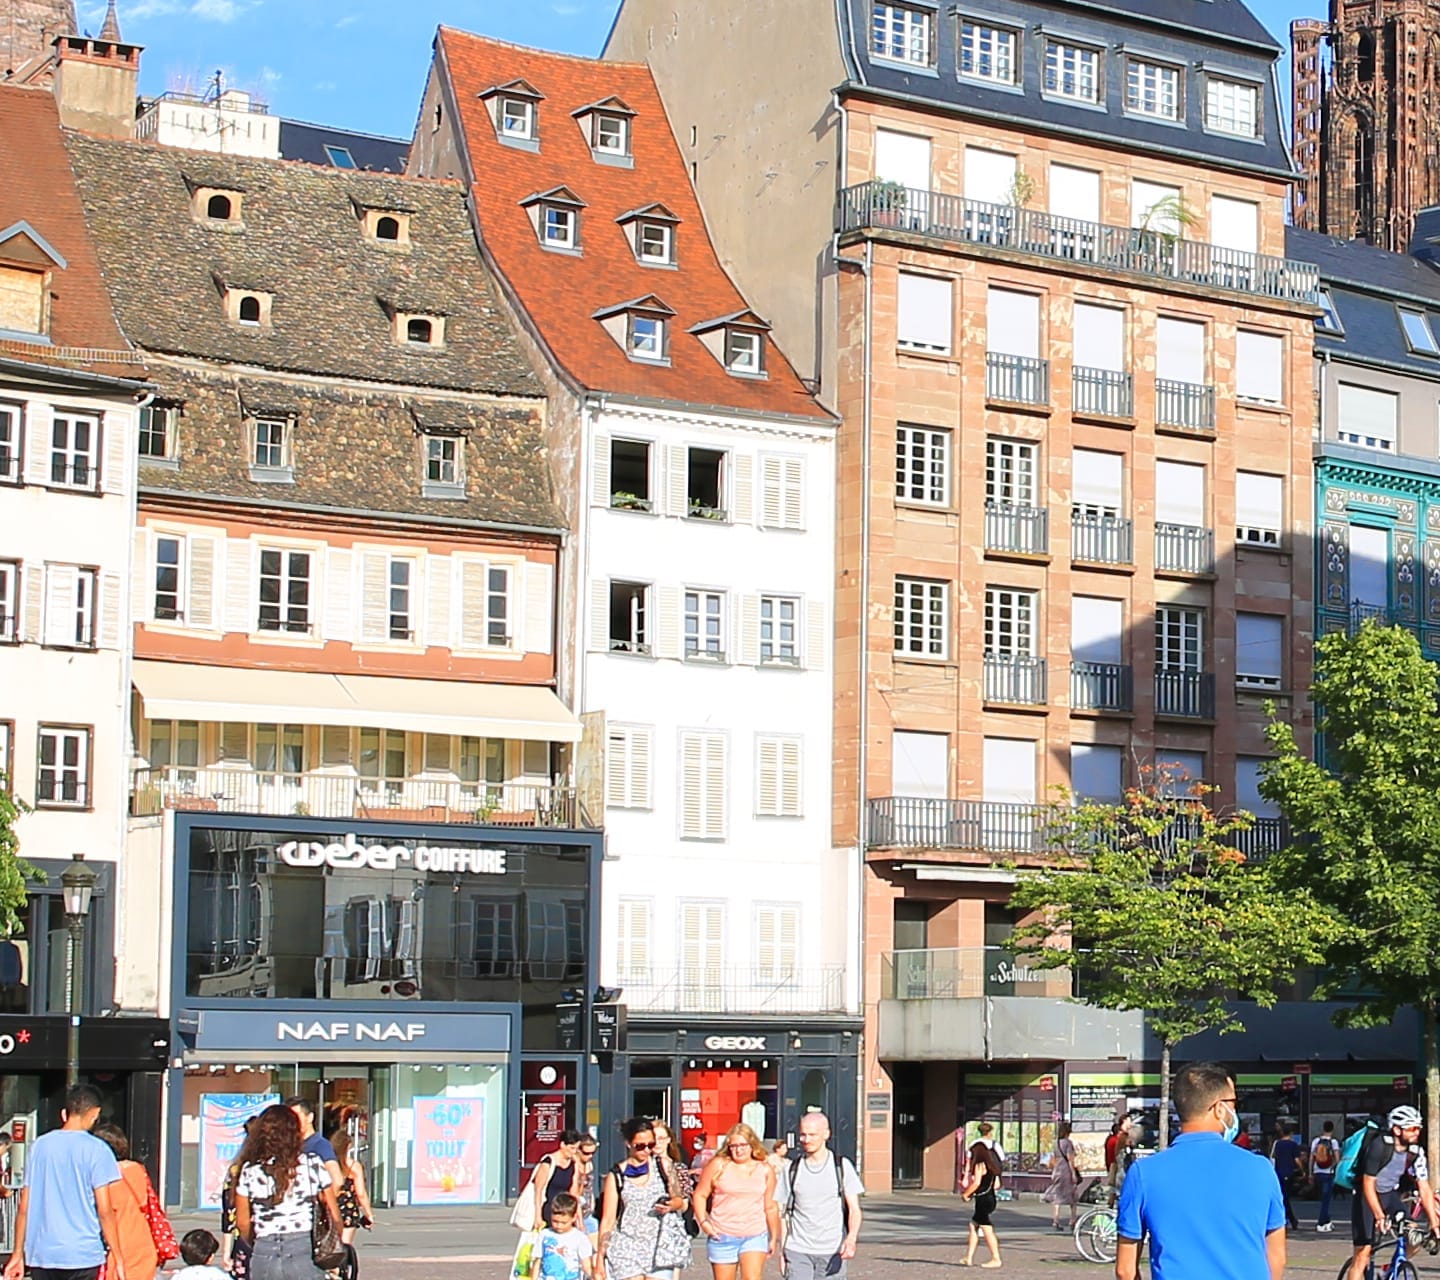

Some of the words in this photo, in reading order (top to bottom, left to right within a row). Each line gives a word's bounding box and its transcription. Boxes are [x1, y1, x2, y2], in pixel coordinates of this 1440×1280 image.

[415, 846, 507, 874] COIFFURE
[278, 1022, 350, 1041] NAF
[356, 1023, 425, 1041] NAF
[704, 1036, 766, 1050] GEOX
[427, 1140, 467, 1158] TOUT
